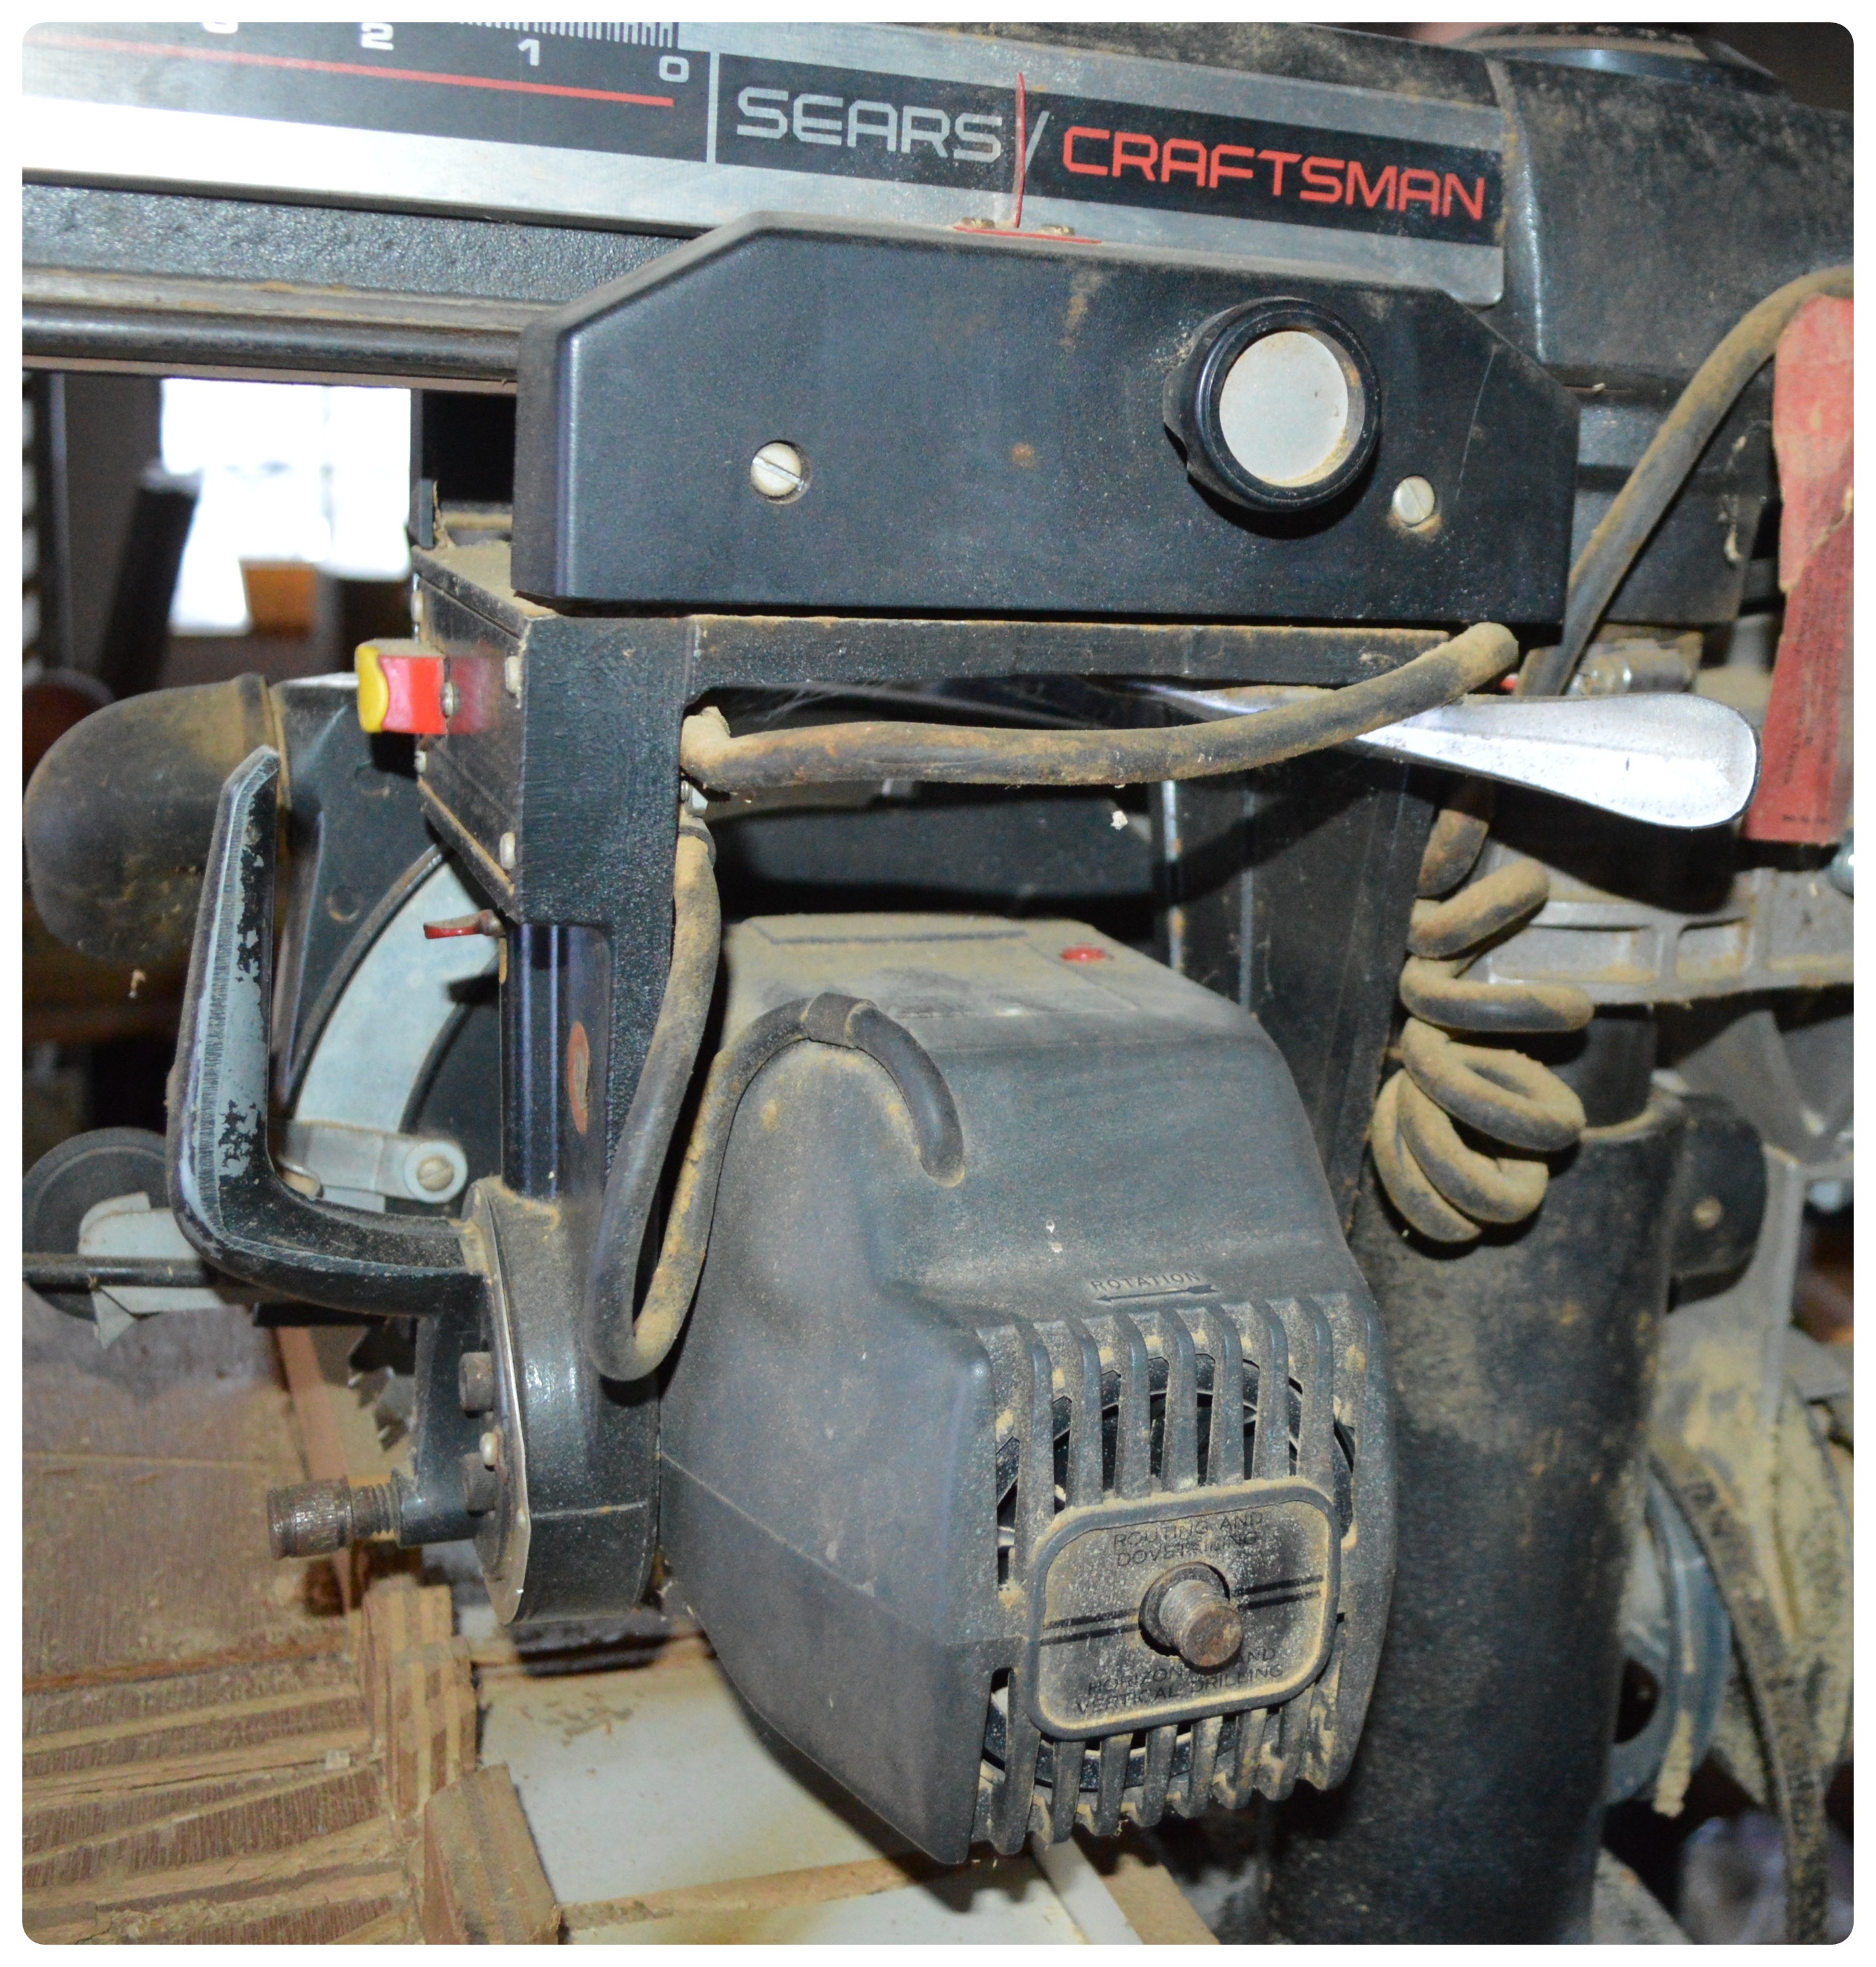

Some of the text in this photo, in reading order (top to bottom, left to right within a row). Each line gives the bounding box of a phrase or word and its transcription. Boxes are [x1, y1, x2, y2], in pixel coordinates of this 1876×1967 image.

[361, 22, 690, 83] 2 1 0
[1063, 126, 1485, 220] CRAFTSMAN
[1091, 1271, 1202, 1291] ROTATION
[1114, 1512, 1264, 1549] ROUTING AND
[1088, 1666, 1183, 1695] HORIZON
[1190, 1663, 1283, 1694] DRILLING
